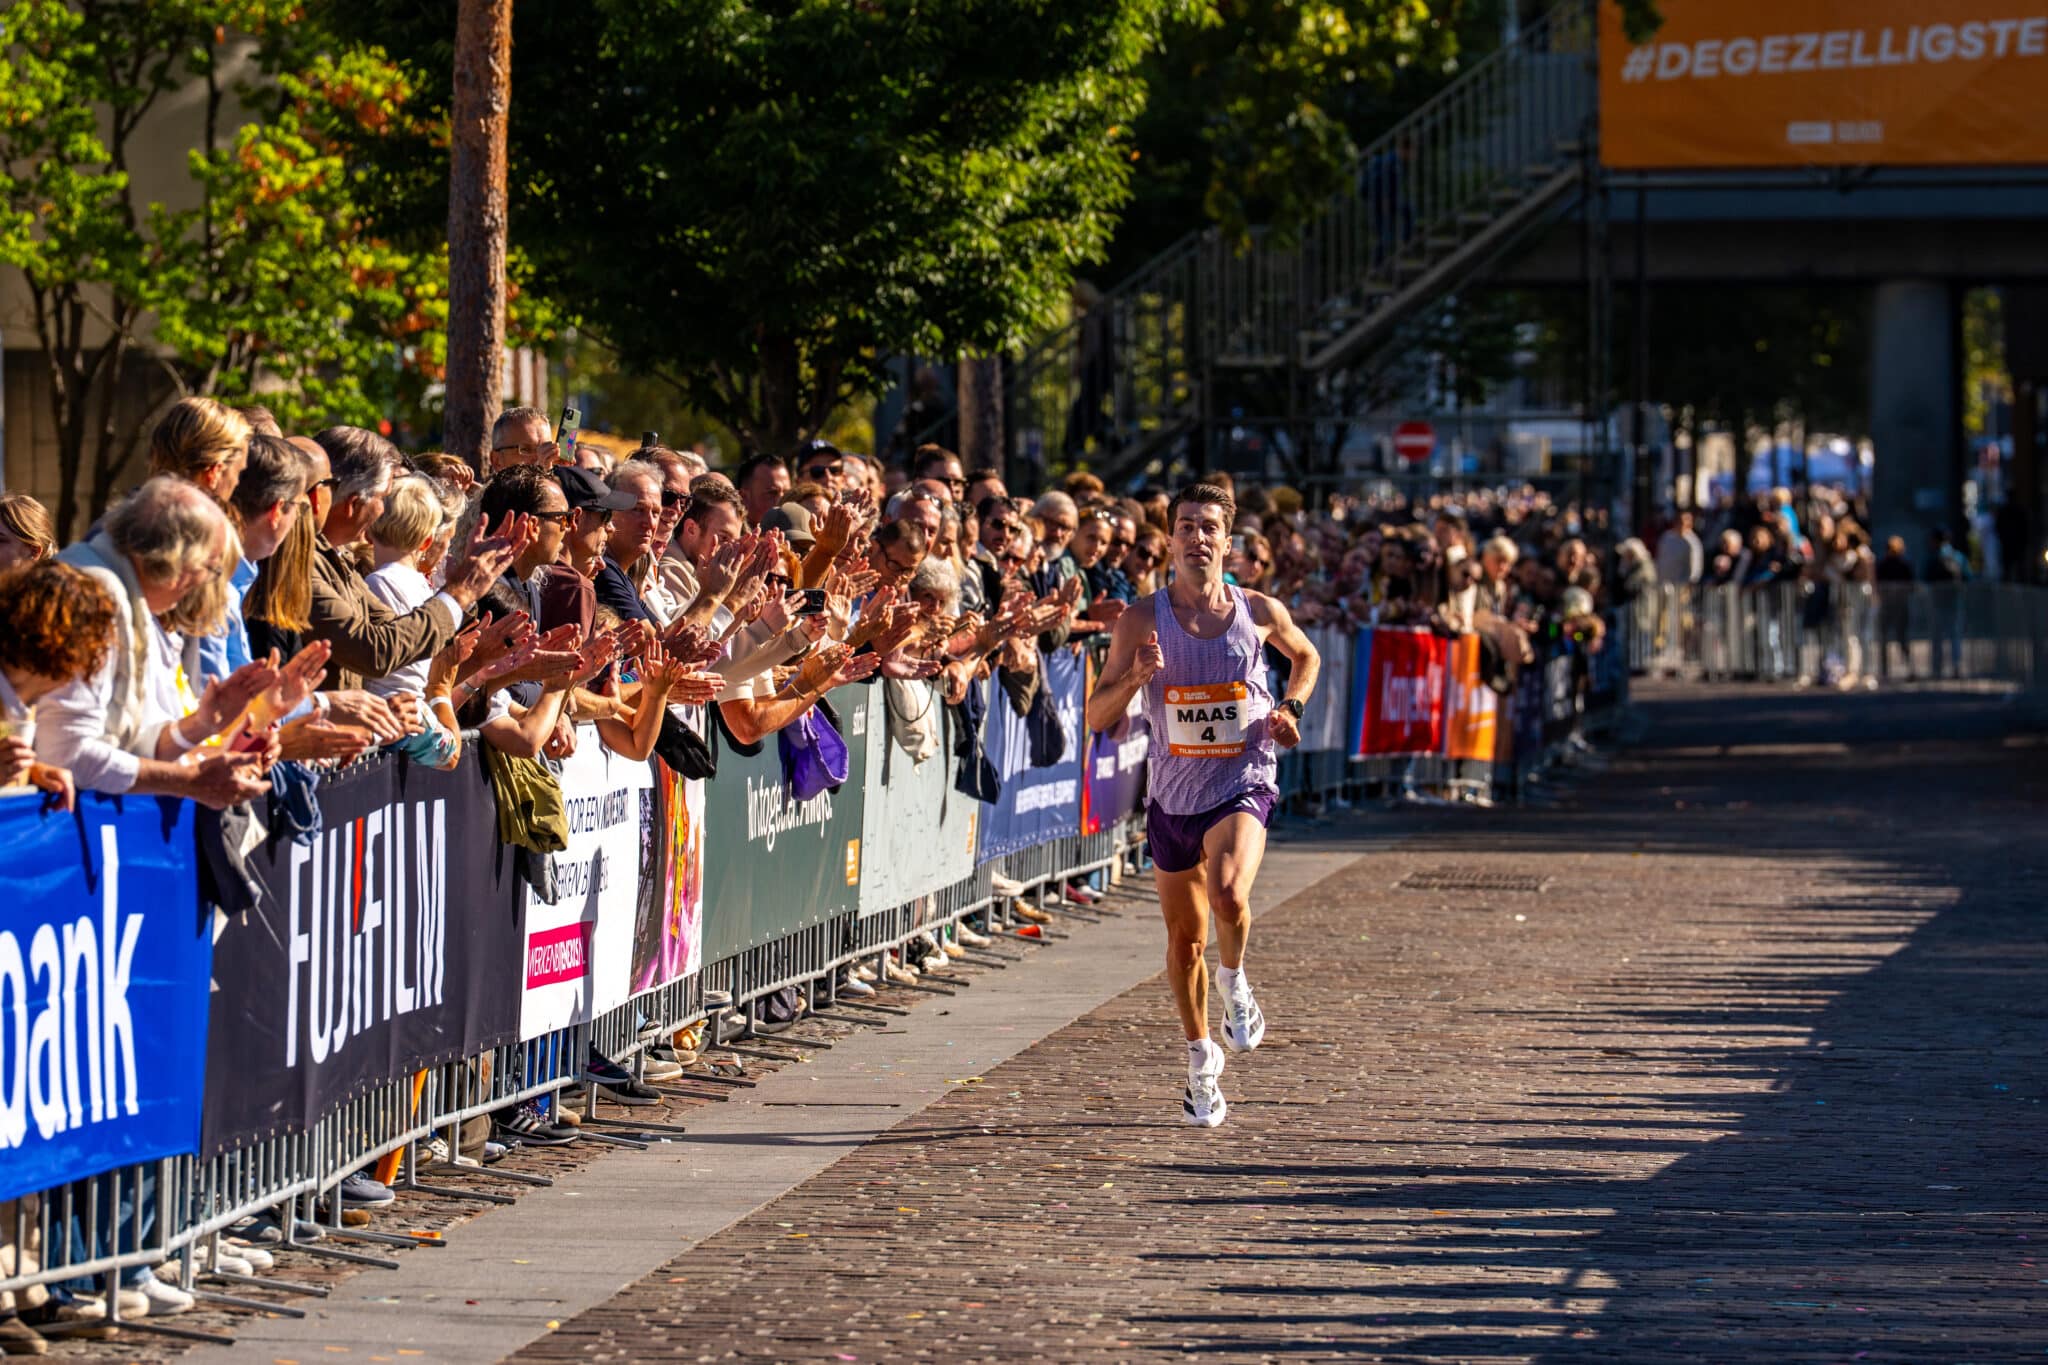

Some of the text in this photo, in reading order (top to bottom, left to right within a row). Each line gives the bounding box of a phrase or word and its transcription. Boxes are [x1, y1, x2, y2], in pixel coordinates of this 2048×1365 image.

[1177, 706, 1237, 722] MAAS
[1201, 726, 1216, 742] 4
[286, 798, 446, 1067] FUJIFILM
